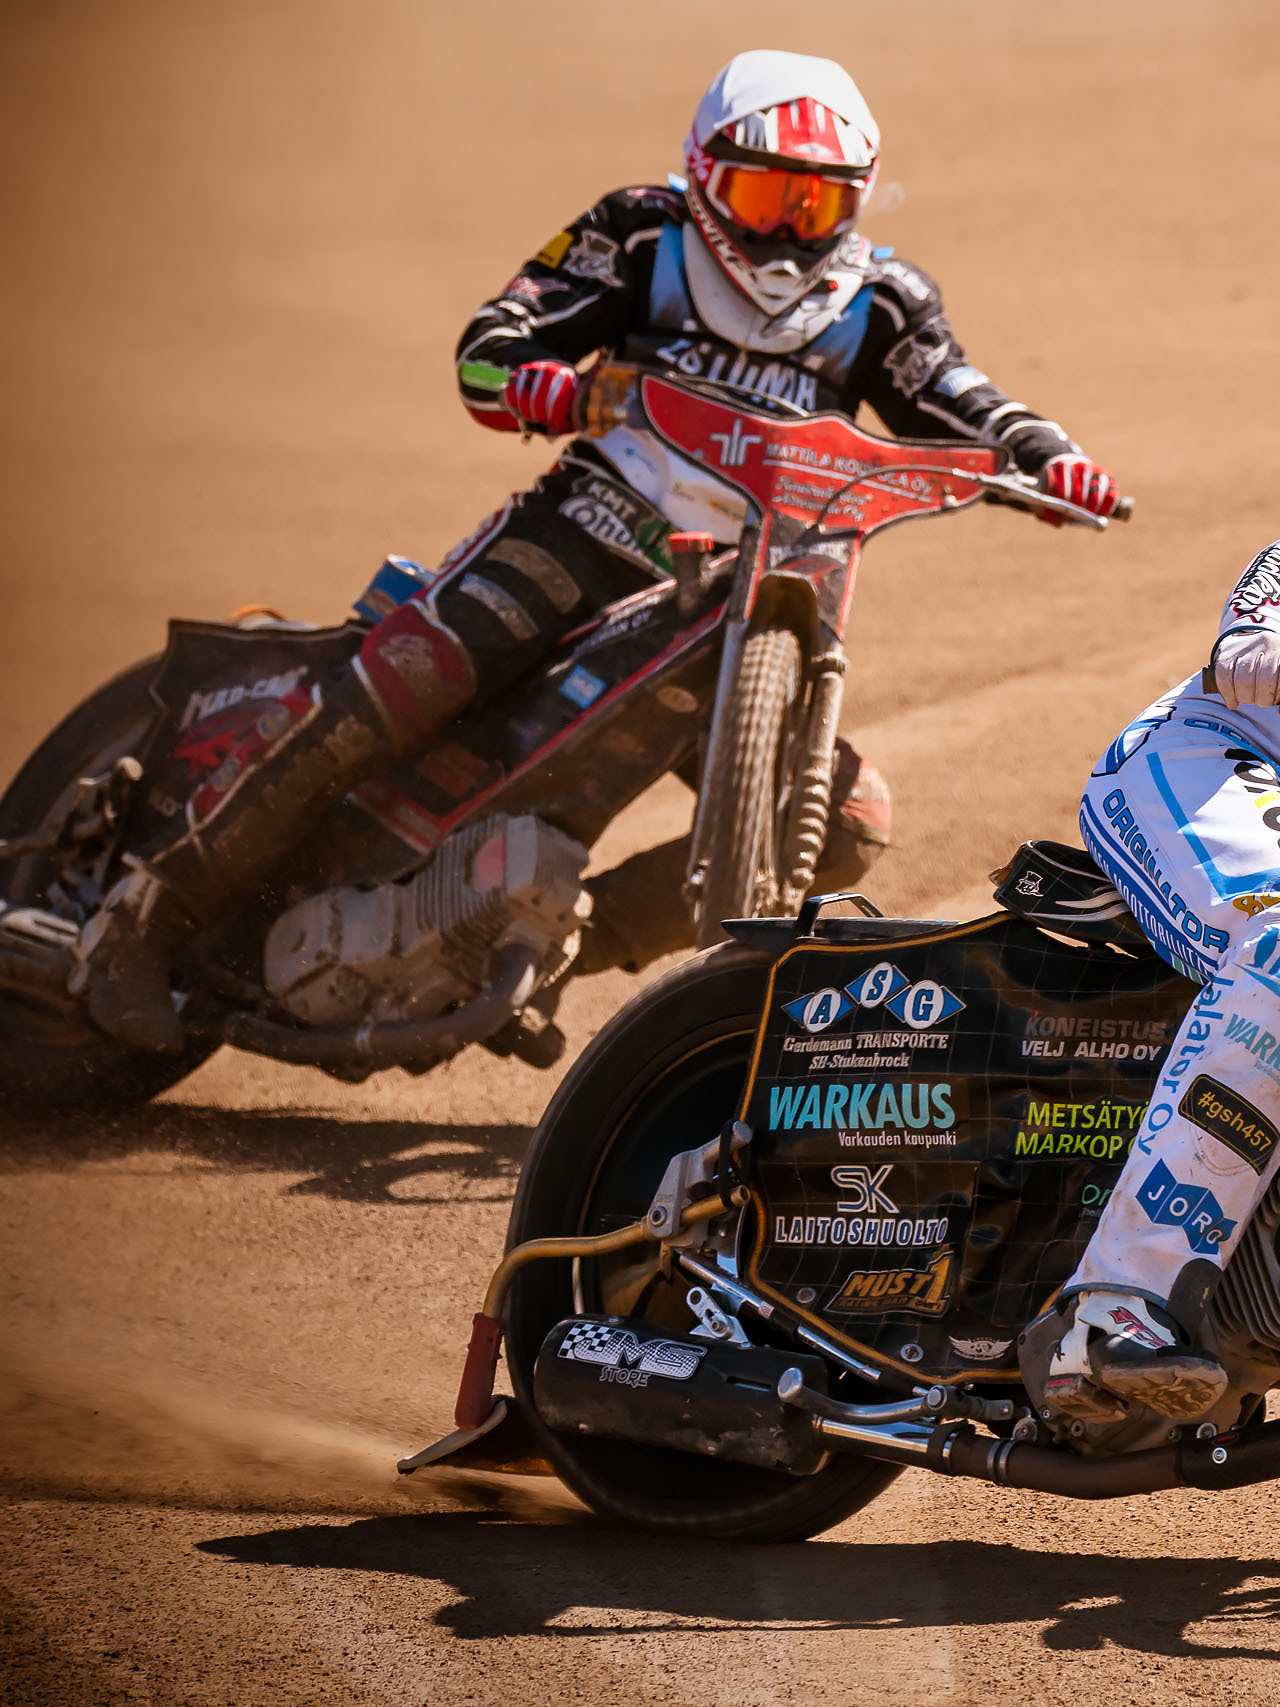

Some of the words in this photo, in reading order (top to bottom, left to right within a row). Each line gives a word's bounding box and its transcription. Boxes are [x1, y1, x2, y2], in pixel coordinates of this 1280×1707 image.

[1103, 788, 1230, 954] ORIGINATOR
[1024, 1016, 1168, 1041] KONEISTUS
[783, 1036, 853, 1053] Gerdemann
[856, 1033, 950, 1049] TRANSPORTE
[1074, 1041, 1129, 1060] ALHO
[1132, 1045, 1163, 1062] OY
[809, 1052, 912, 1070] SH-Stukenbrock
[768, 1083, 956, 1131] WARKAUS
[1137, 1102, 1175, 1157] Oy
[1197, 1090, 1273, 1153] #gsh457
[838, 1131, 901, 1147] Varkauden
[904, 1130, 957, 1149] kaupunki
[1015, 1131, 1123, 1159] MARKOP
[830, 1163, 901, 1214] SK
[774, 1215, 949, 1246] LAITOSHUOLTO
[600, 1365, 650, 1389] STORE
